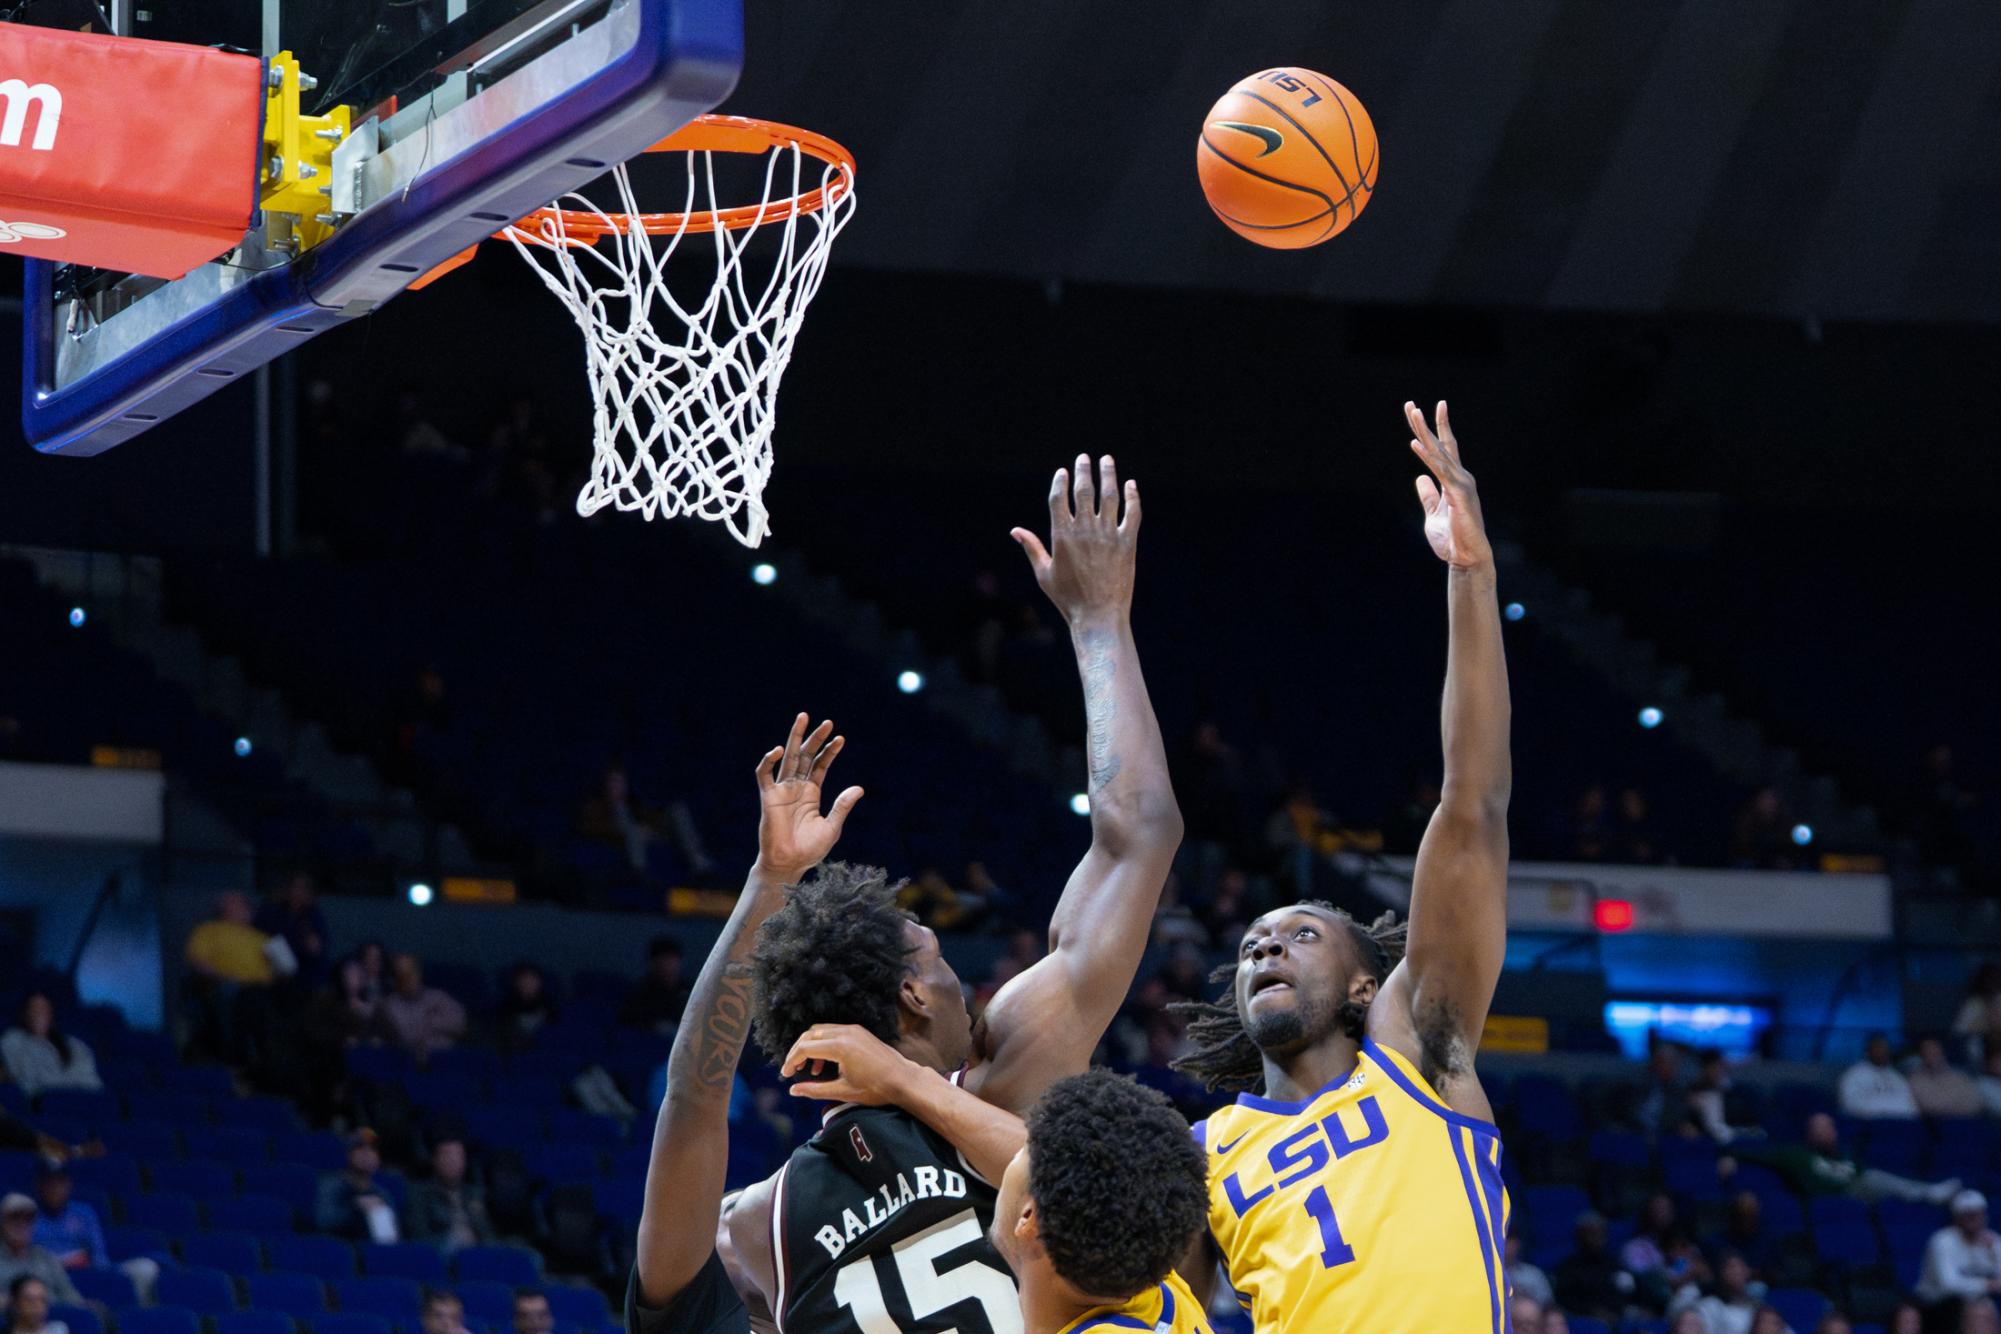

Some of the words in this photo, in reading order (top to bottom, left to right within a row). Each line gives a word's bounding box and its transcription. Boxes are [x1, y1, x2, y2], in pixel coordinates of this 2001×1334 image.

[1257, 71, 1322, 108] LSU
[1222, 1095, 1390, 1220] LSU
[814, 1165, 968, 1260] BALLARD
[1303, 1184, 1356, 1269] 1
[833, 1206, 1025, 1334] 15
